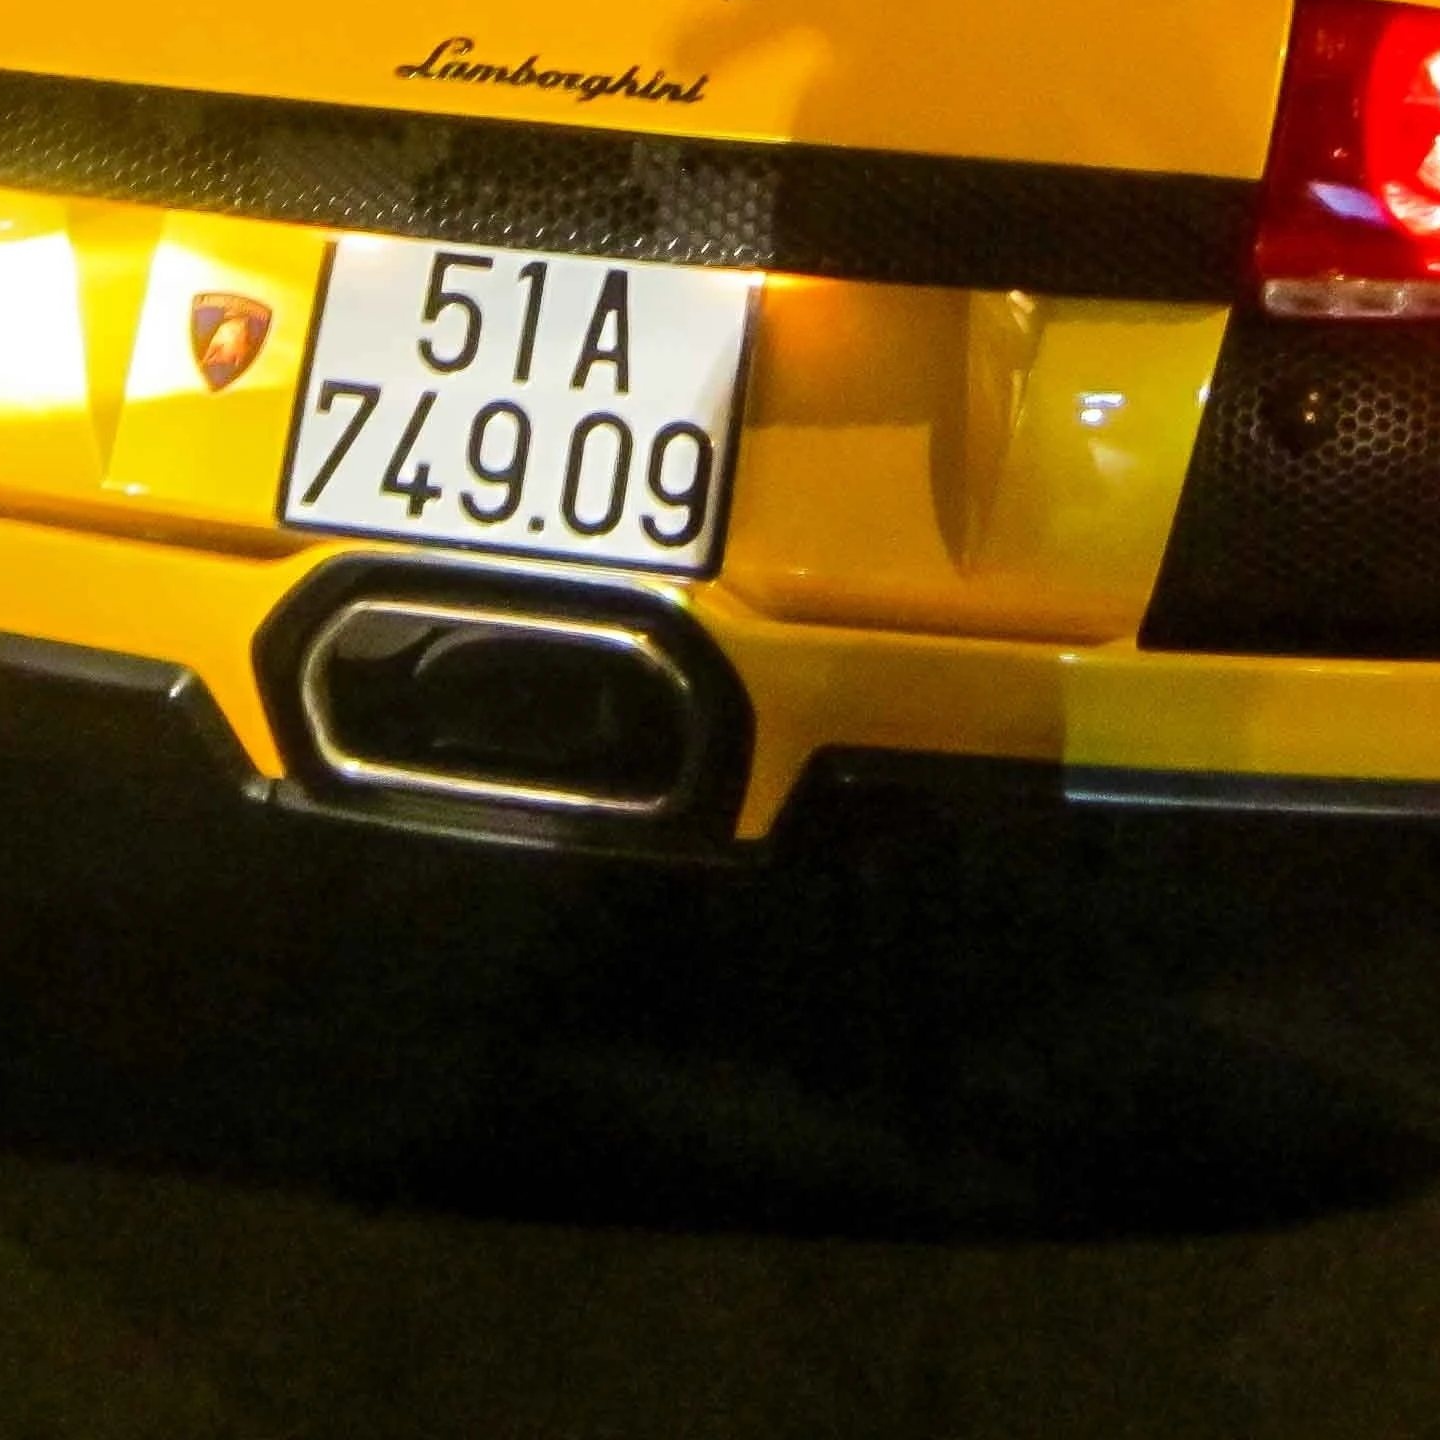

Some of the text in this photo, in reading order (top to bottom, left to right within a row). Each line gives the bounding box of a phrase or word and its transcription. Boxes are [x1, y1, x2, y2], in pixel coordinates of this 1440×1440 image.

[394, 35, 711, 105] Lamborghini
[415, 251, 632, 394] 51A
[299, 379, 714, 548] 749.09
